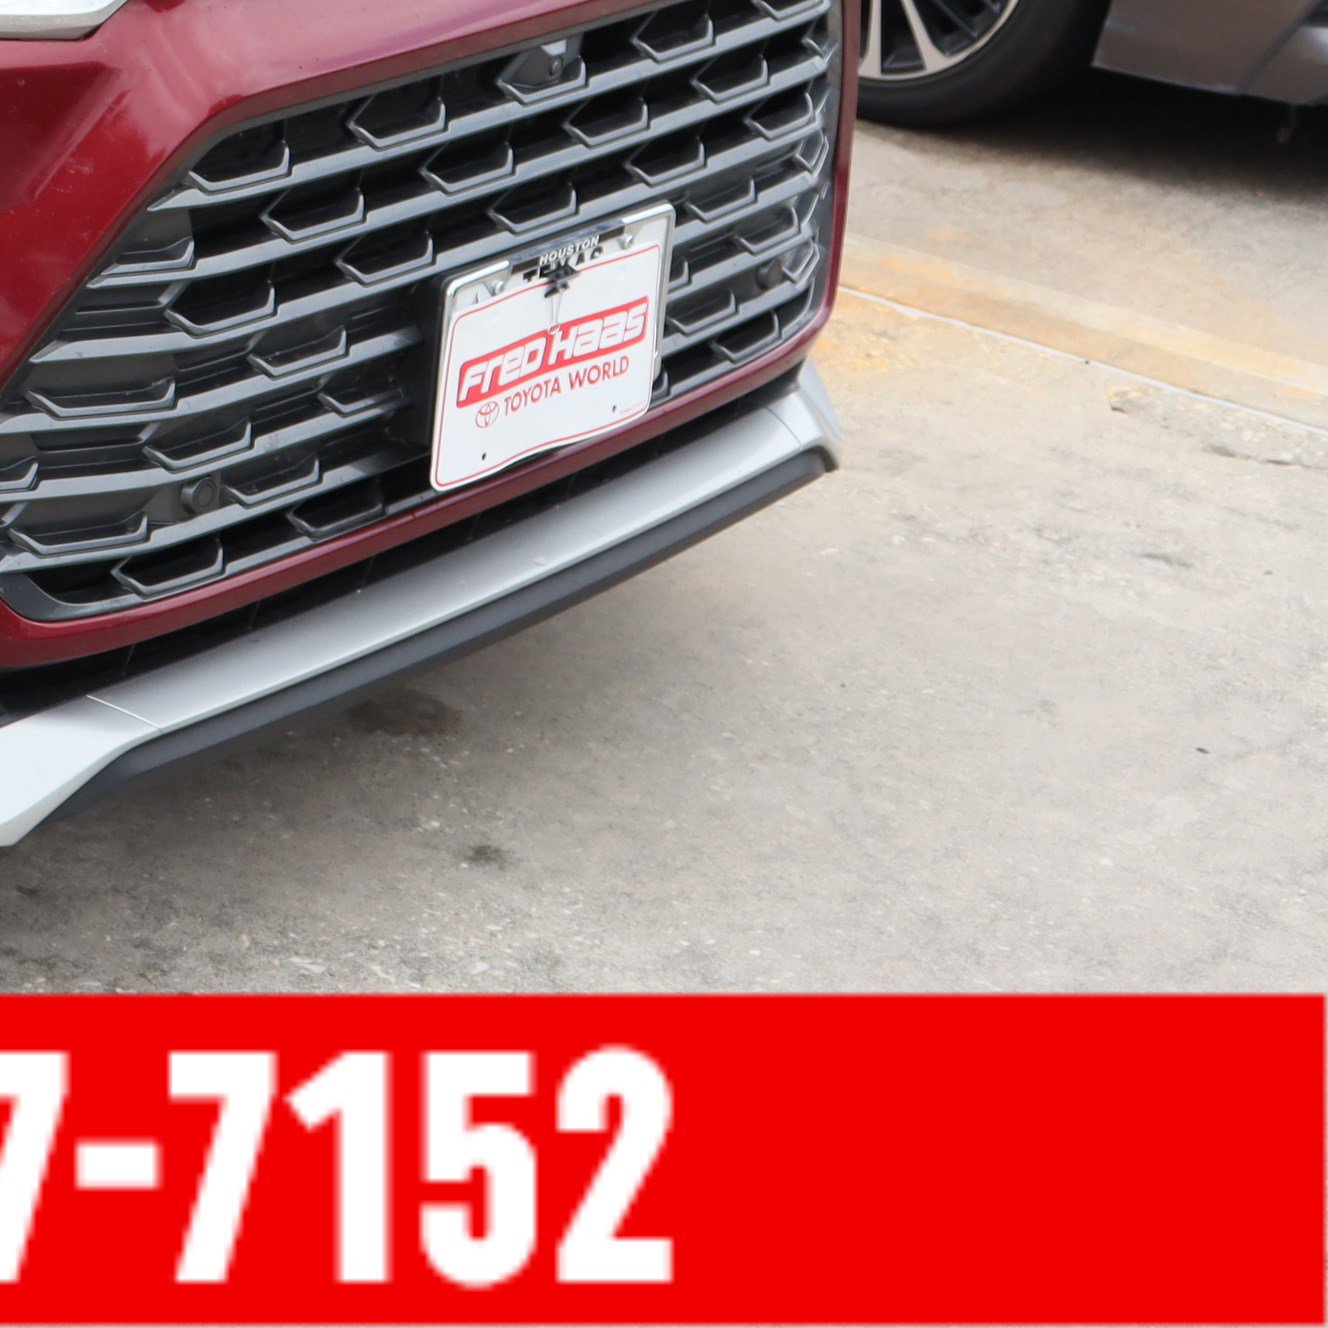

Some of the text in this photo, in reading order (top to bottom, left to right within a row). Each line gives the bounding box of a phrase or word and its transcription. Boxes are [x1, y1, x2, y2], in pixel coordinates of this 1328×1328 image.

[538, 235, 600, 267] HOUSTON
[504, 354, 630, 417] TOYOTA WORLD
